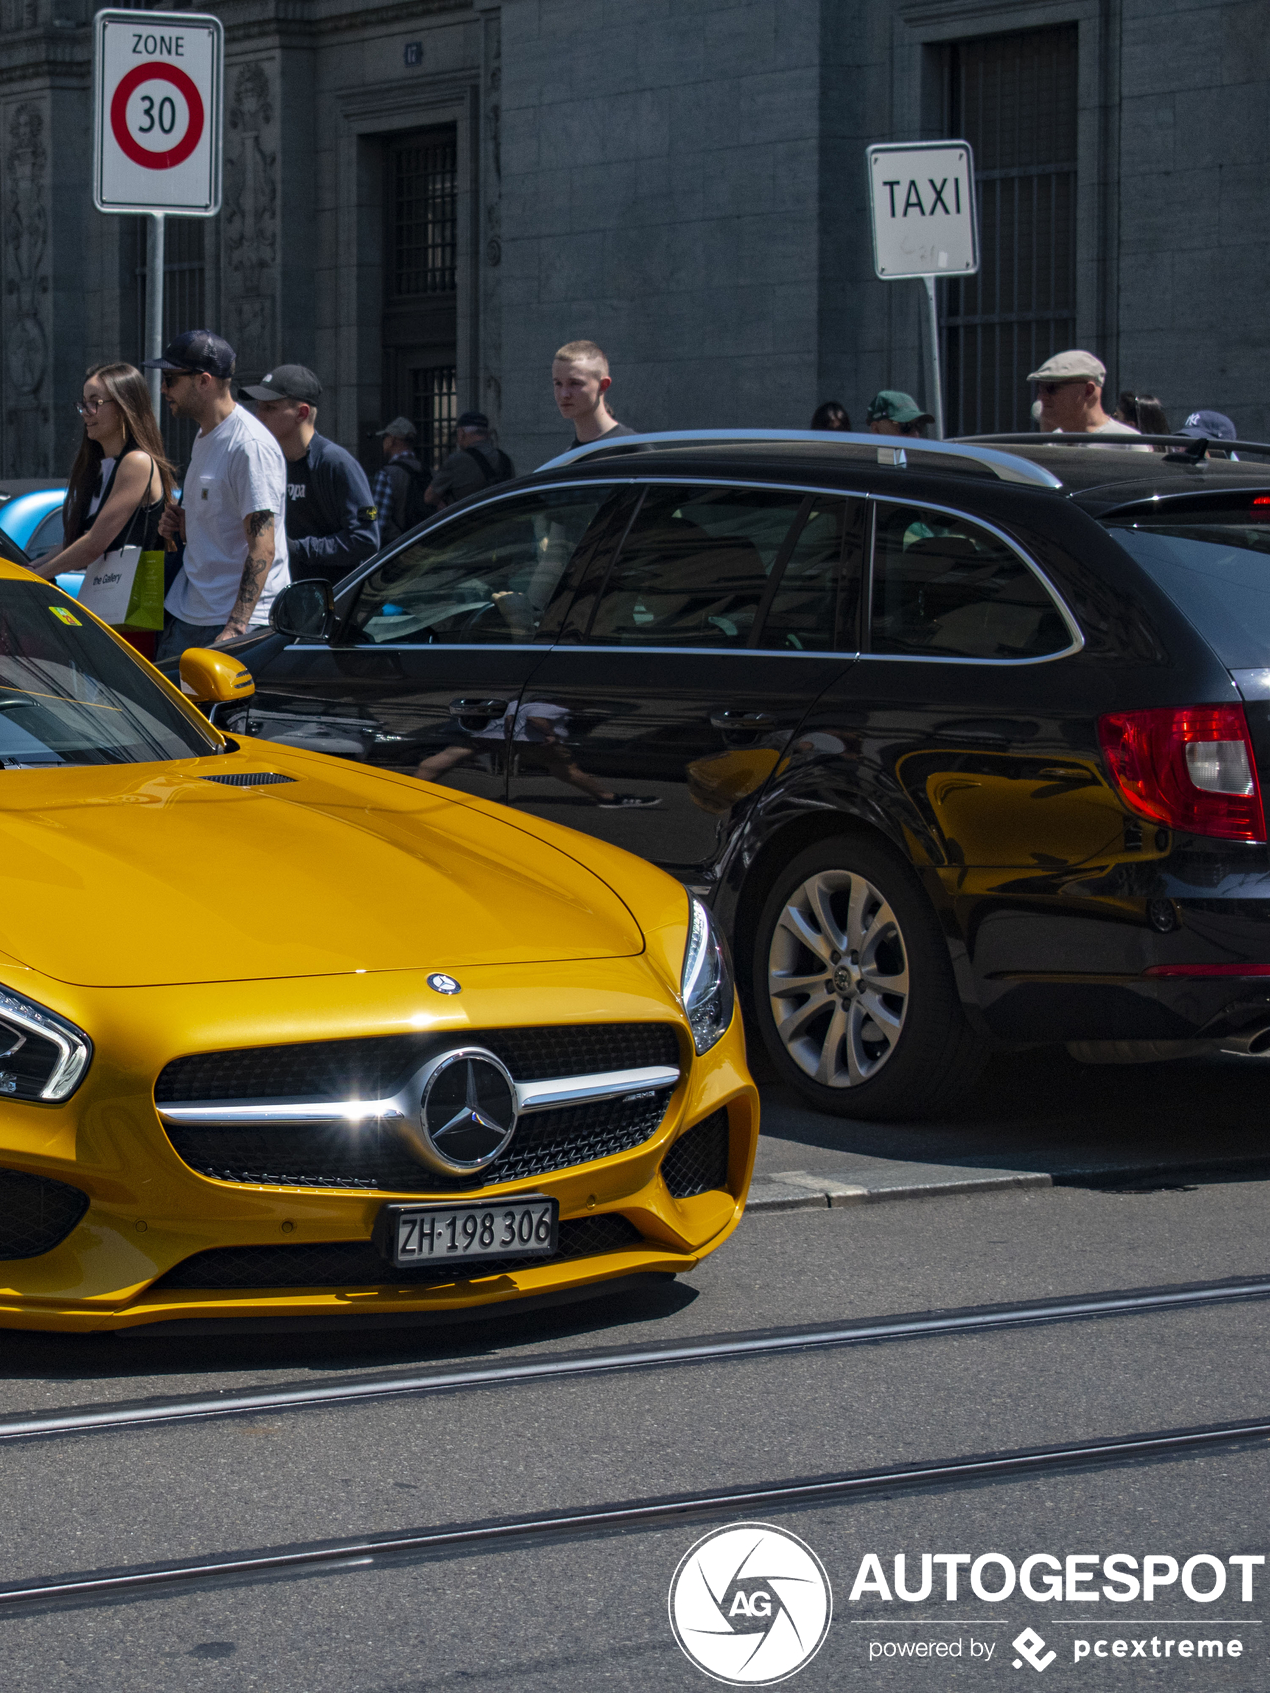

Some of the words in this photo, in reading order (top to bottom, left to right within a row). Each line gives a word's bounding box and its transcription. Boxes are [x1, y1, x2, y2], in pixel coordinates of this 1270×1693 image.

[132, 33, 185, 57] ZONE
[138, 95, 176, 135] 30
[882, 177, 961, 218] TAXI
[287, 483, 306, 501] opa
[93, 575, 103, 586] the
[103, 573, 123, 585] Gallery
